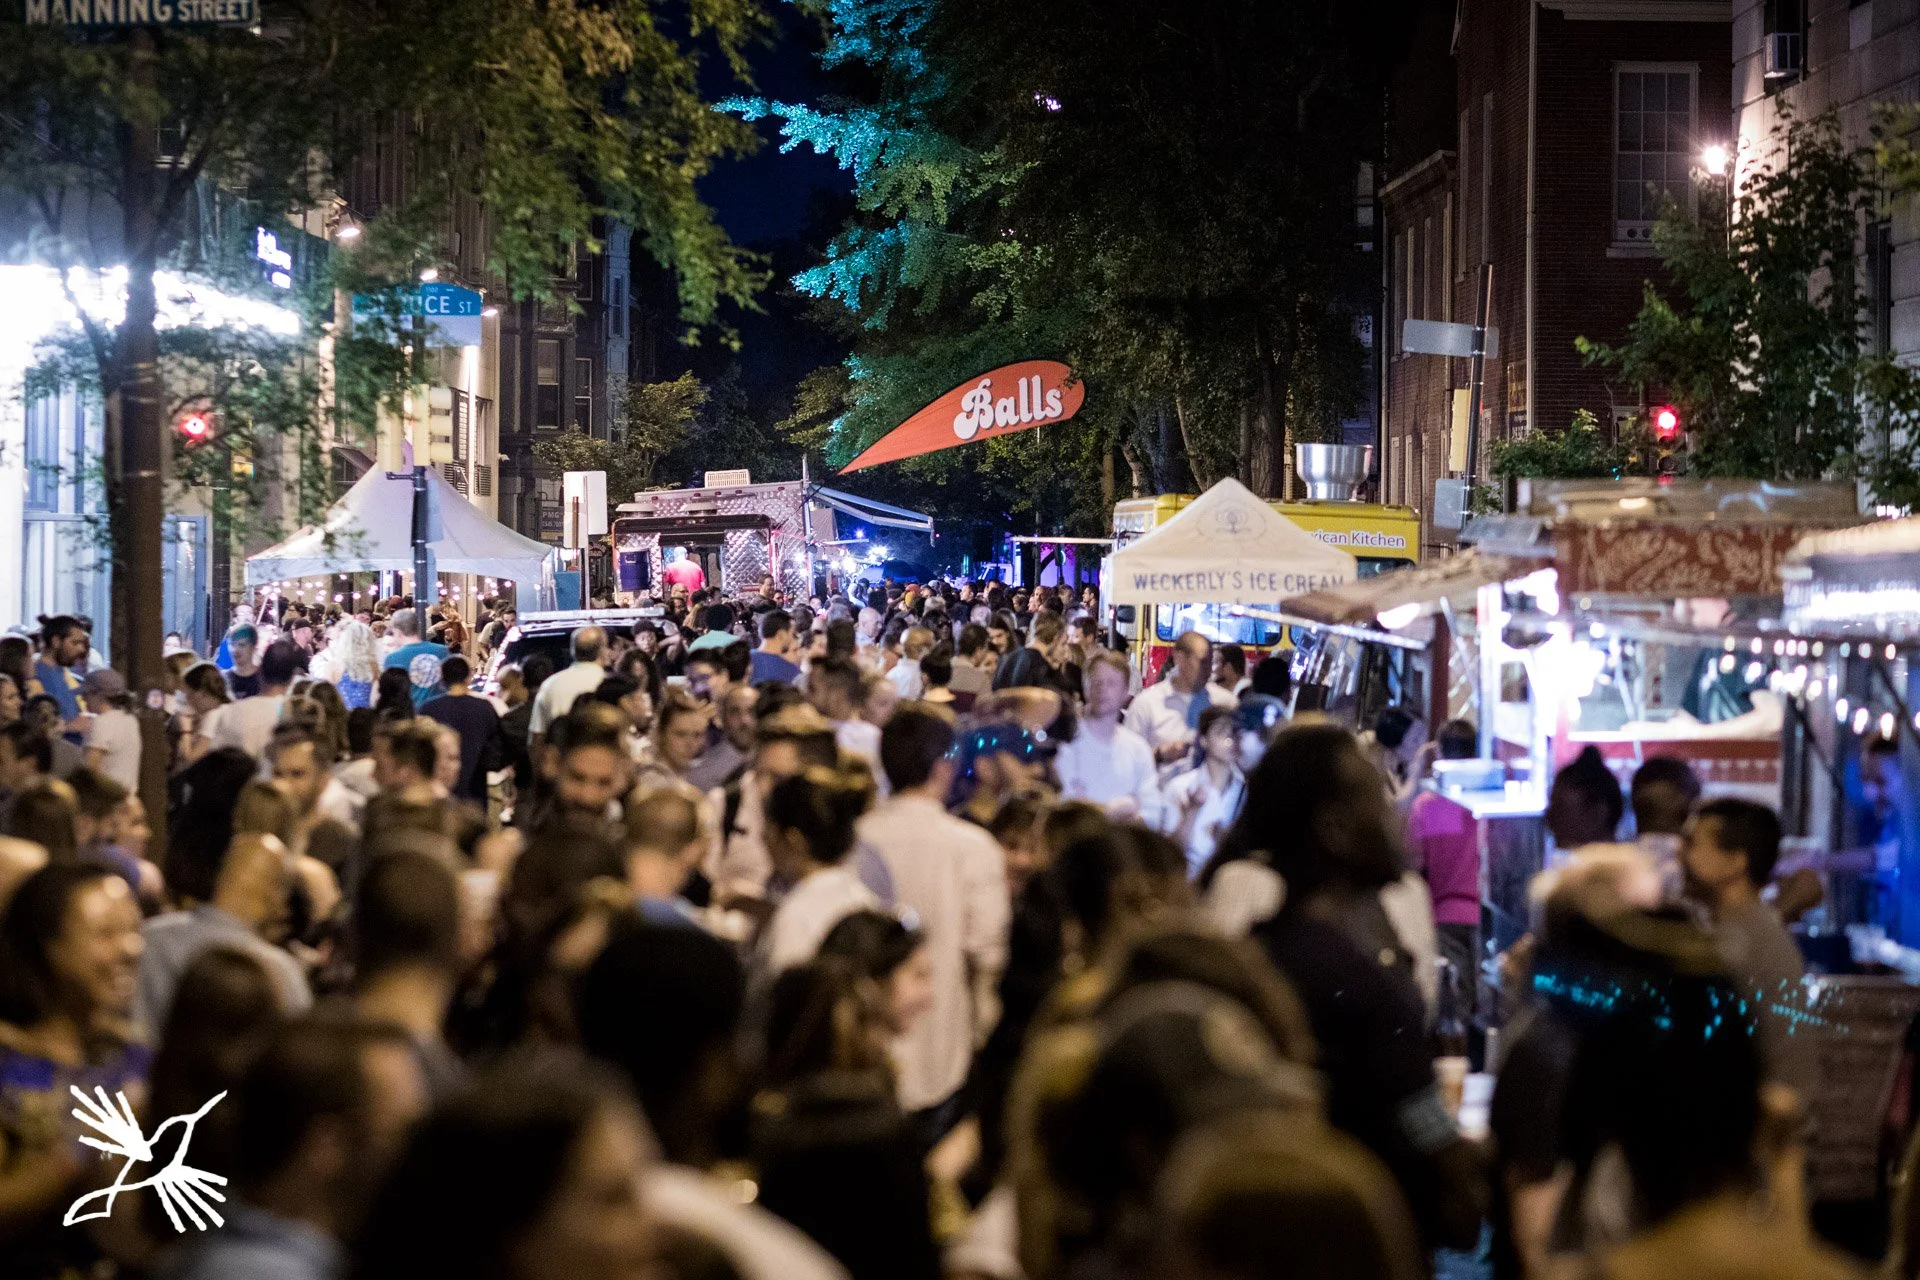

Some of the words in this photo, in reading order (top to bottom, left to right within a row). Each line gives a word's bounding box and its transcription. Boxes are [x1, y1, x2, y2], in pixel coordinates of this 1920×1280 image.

[25, 0, 171, 24] MANNING
[178, 0, 249, 21] STREET
[458, 301, 473, 314] ST
[953, 374, 1064, 440] Balls
[542, 511, 560, 519] PMG
[1351, 532, 1405, 547] Kitchen
[1133, 571, 1243, 592] WECKERLY'S
[1250, 572, 1277, 592] ICE
[1283, 573, 1345, 593] CREAM
